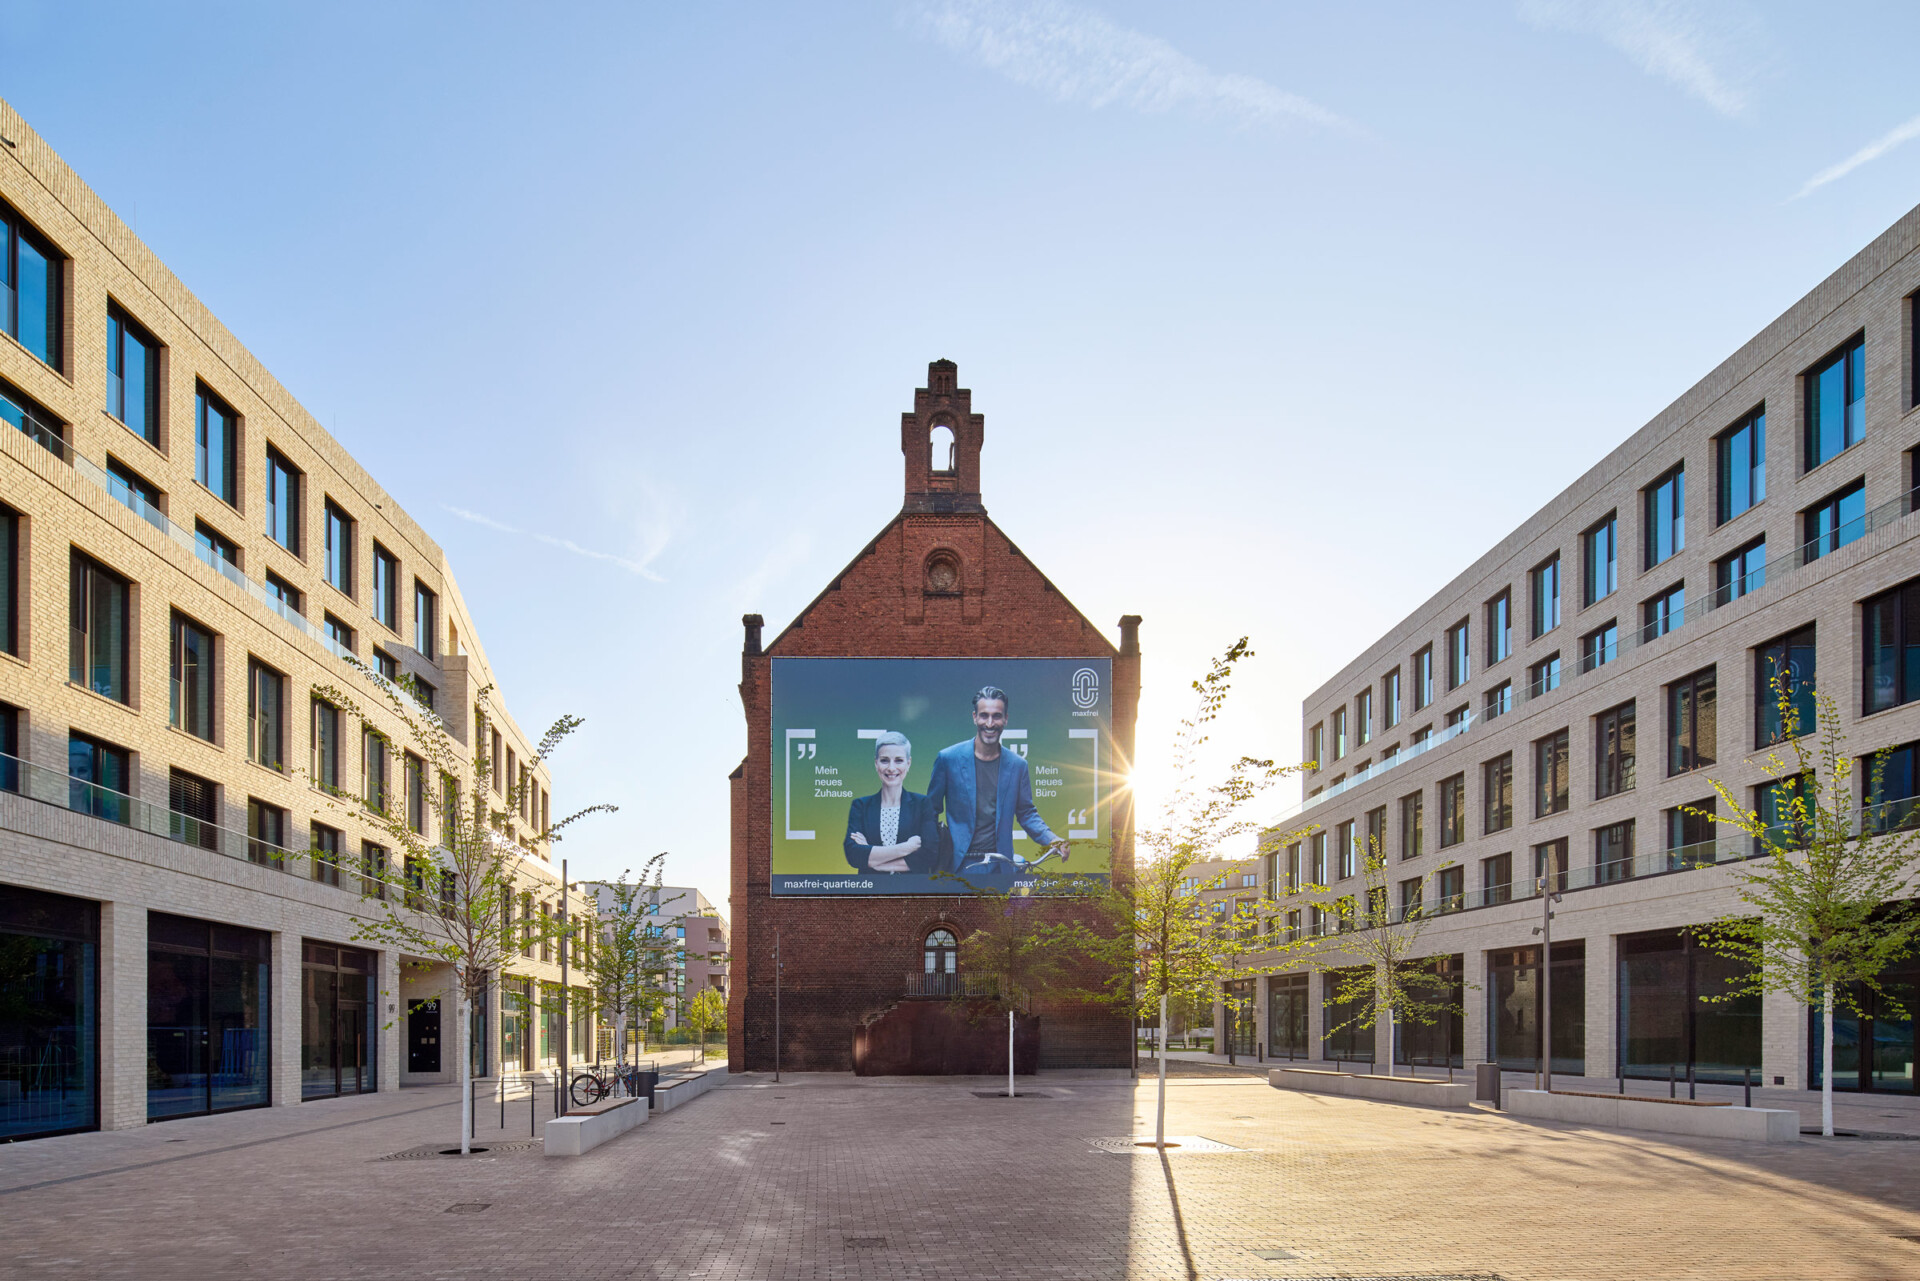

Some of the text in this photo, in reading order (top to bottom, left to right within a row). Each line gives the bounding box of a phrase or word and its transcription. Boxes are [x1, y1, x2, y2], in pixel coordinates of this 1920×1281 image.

[815, 766, 838, 774] Mein
[1036, 766, 1058, 774] Mein
[815, 789, 853, 797] Zuhause
[1036, 789, 1056, 797] Büro
[784, 880, 873, 890] maxfrei-quartier.de
[427, 1002, 436, 1010] 99
